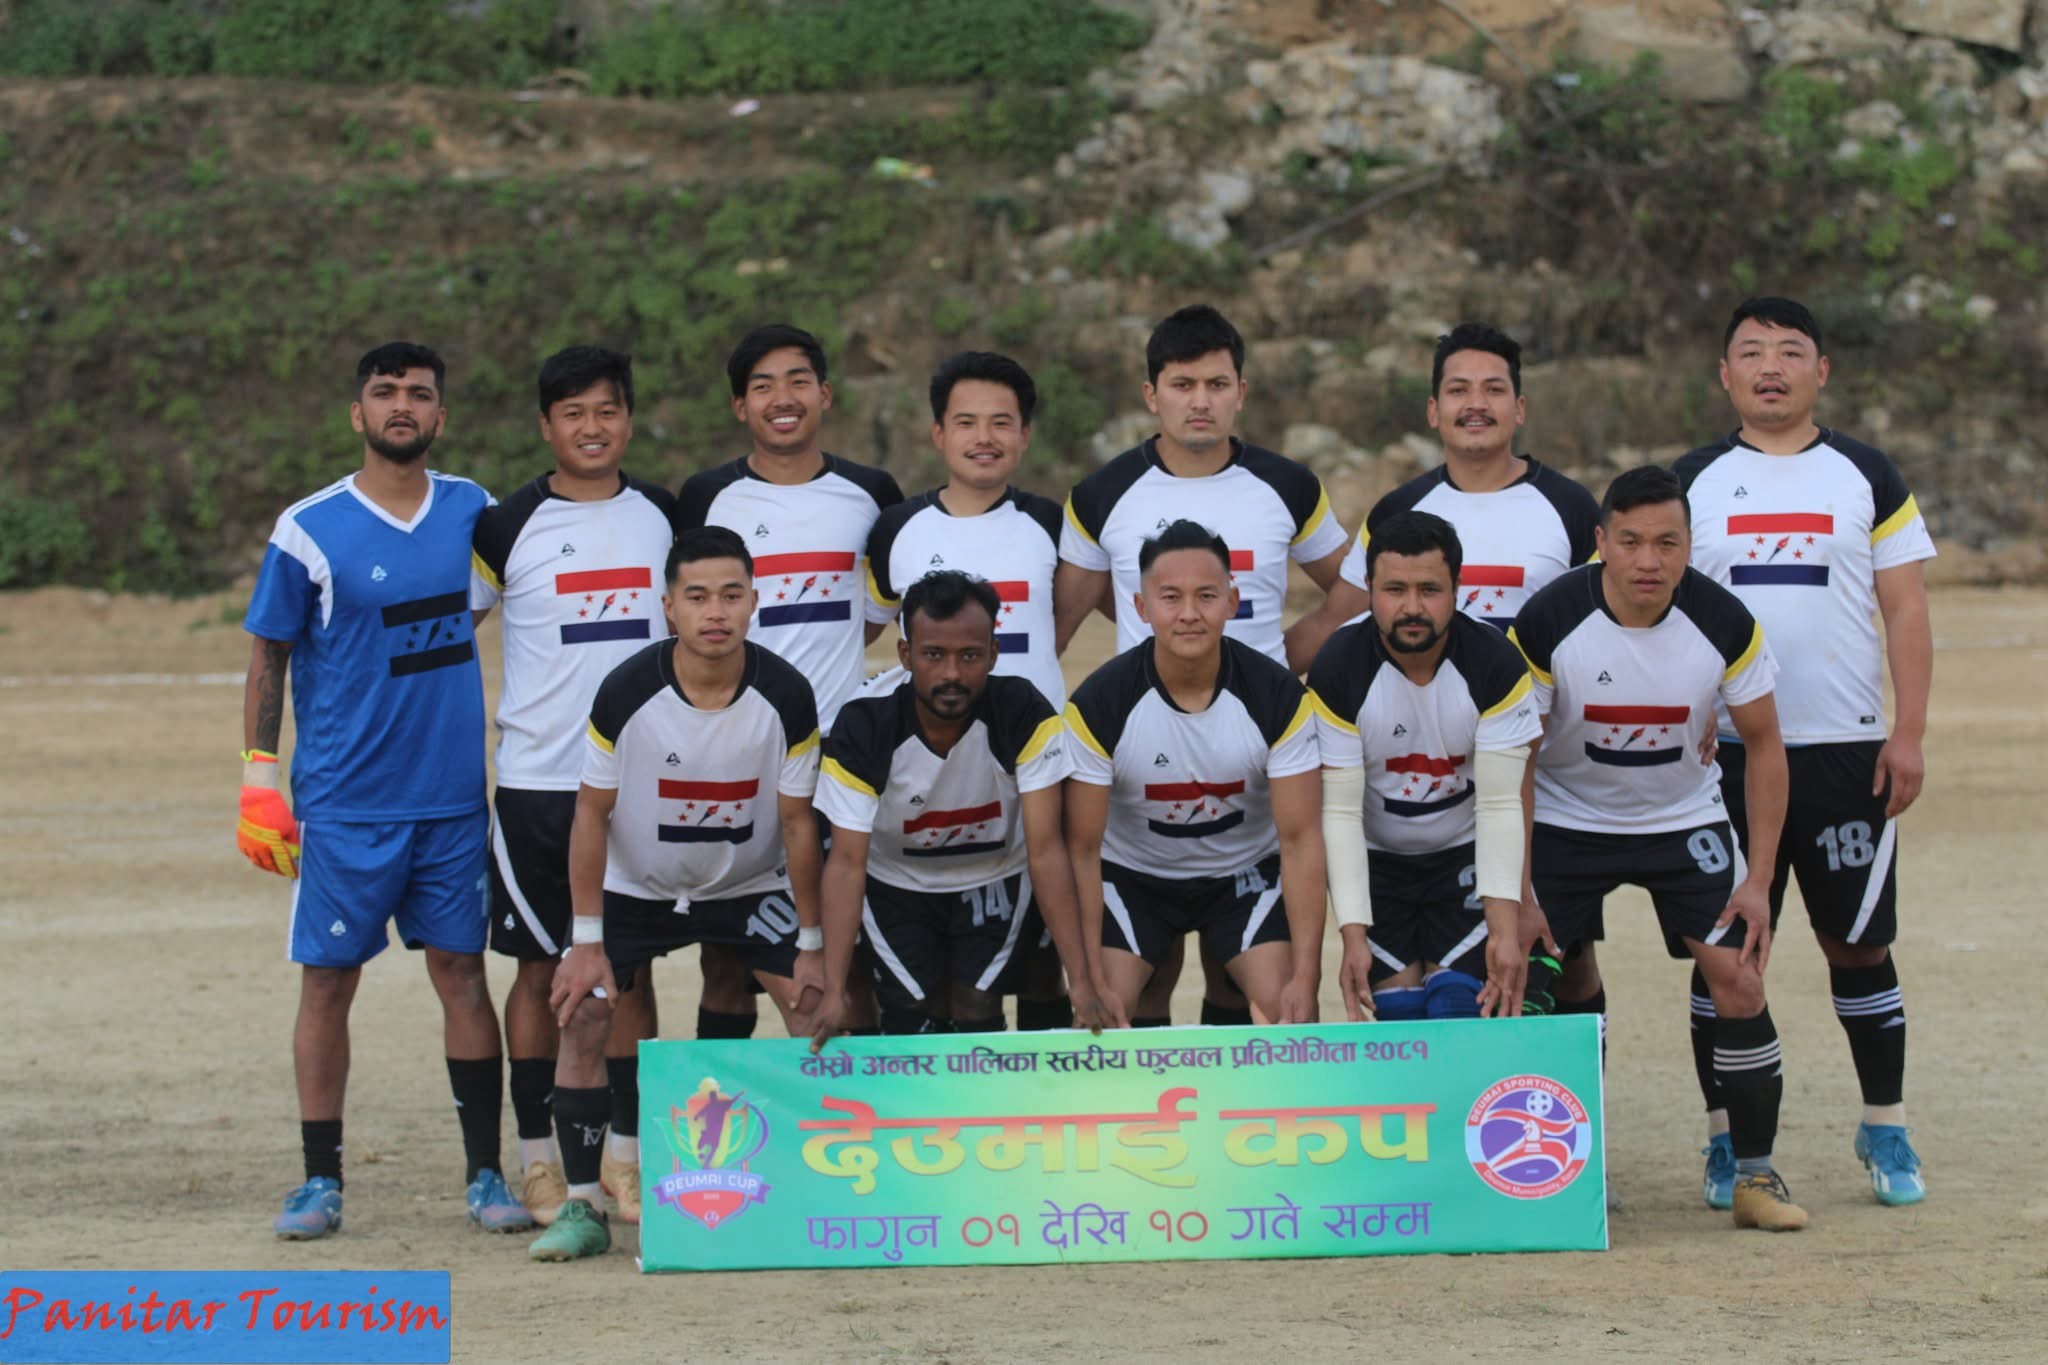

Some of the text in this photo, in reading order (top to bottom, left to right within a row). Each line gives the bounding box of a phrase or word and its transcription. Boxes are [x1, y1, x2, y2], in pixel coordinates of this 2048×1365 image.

[1686, 828, 1730, 874] 9
[1816, 820, 1875, 871] 18
[961, 880, 1013, 926] 14
[1235, 863, 1269, 898] 4
[745, 895, 799, 944] 10
[861, 1055, 939, 1076] अन्तर
[945, 1046, 1038, 1075] पालिका
[1046, 1044, 1128, 1072] स्तरीय
[1136, 1047, 1222, 1074] फुटबल
[1230, 1036, 1358, 1069] प्रतियोगिता
[1364, 1040, 1429, 1062] २०८१
[1503, 1078, 1560, 1095] SPORTING
[798, 1087, 1437, 1195] देउमाई कप
[665, 1173, 758, 1193] DEUMAI CUP
[806, 1193, 1433, 1261] फागुन ०१ देखि १० गते सम्म
